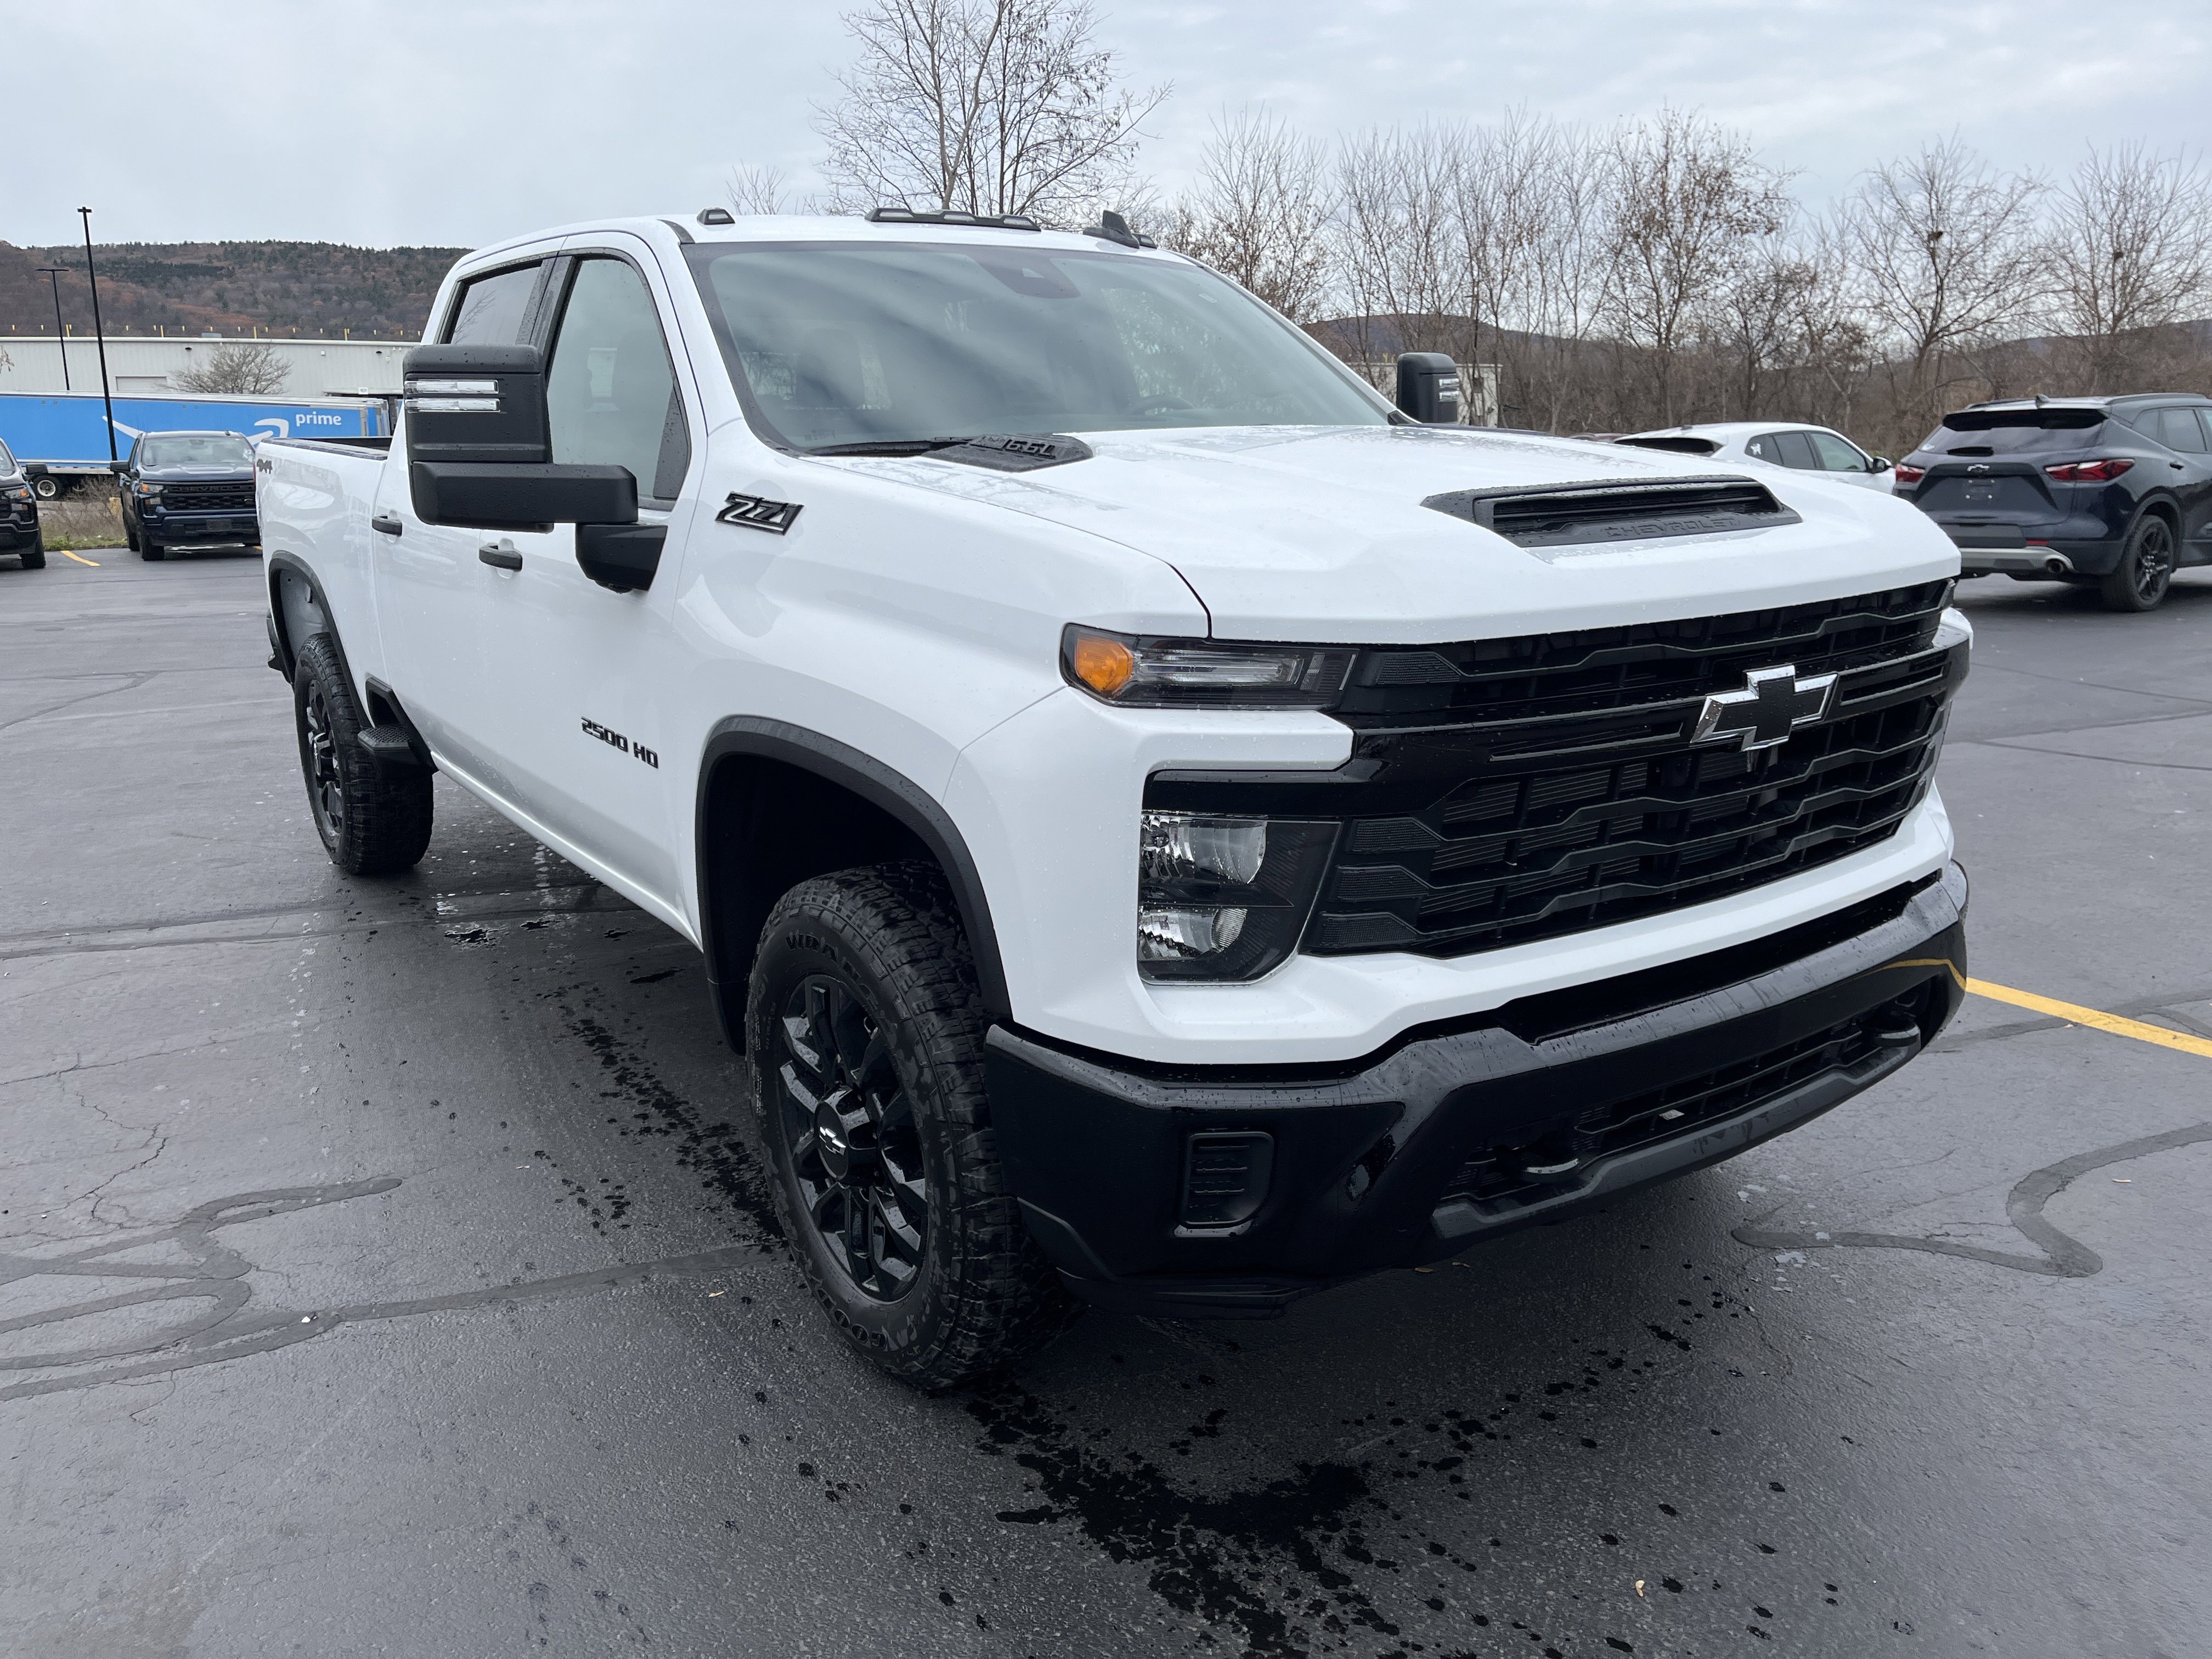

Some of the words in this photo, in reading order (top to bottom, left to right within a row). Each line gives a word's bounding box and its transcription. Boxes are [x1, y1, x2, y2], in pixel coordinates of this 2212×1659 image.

[295, 411, 342, 427] prime
[715, 492, 804, 536] Z71
[1604, 518, 1737, 537] CHEVROLET
[581, 716, 629, 753] 2500
[633, 741, 658, 769] HD
